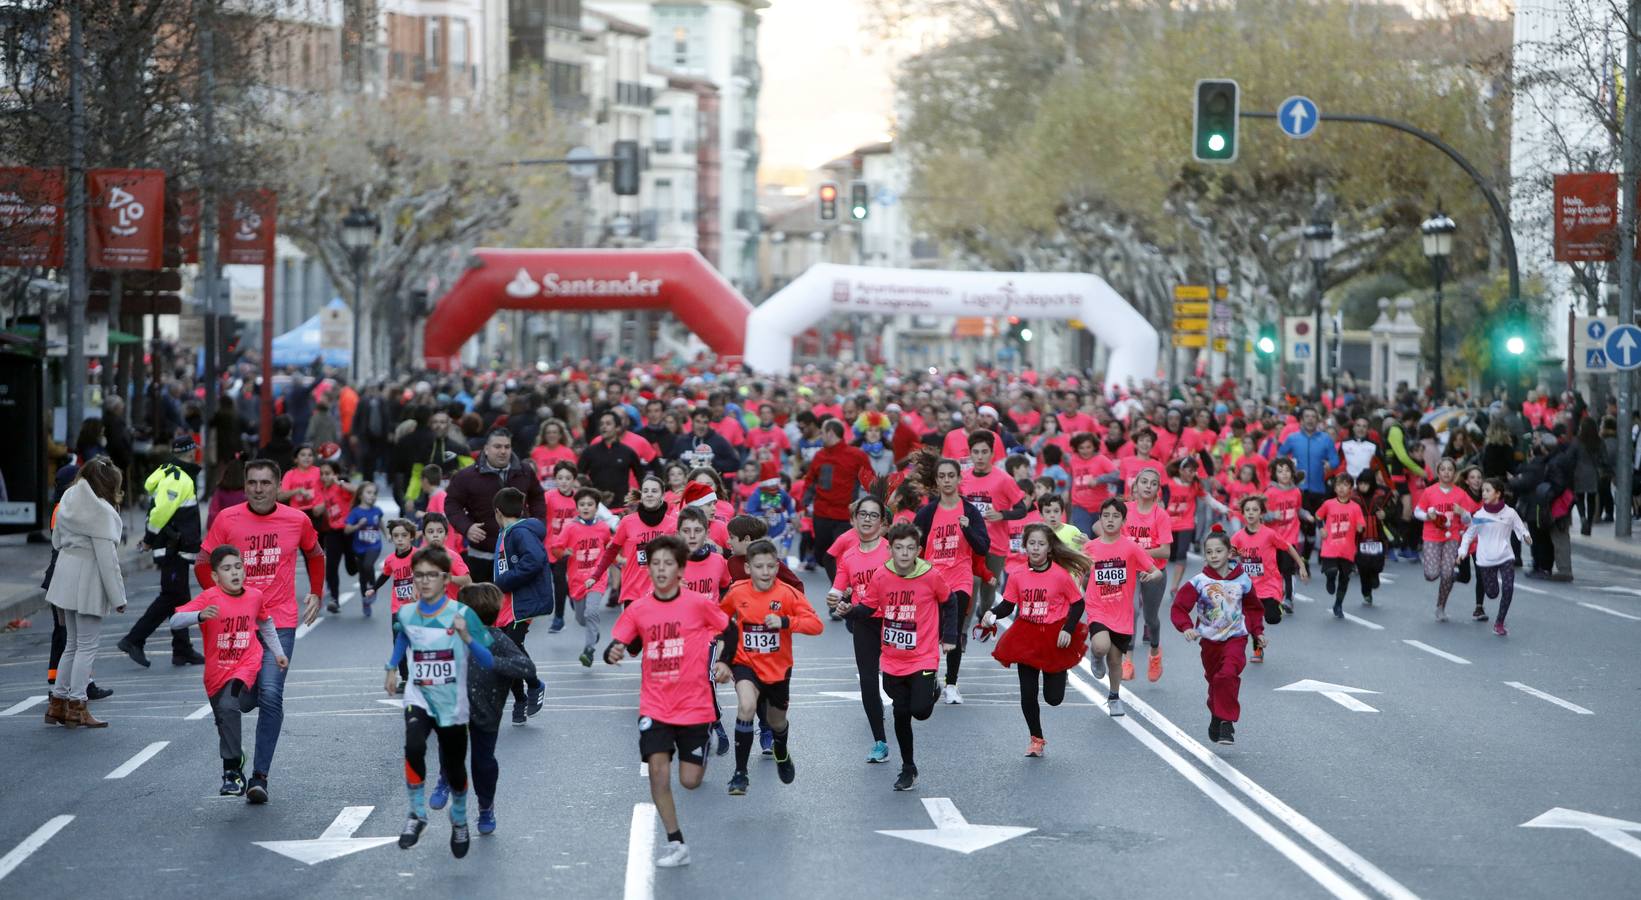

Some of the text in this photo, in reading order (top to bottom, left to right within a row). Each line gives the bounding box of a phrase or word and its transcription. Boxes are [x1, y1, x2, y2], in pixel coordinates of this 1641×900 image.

[542, 271, 664, 298] Santander
[946, 523, 957, 537] DIC
[1138, 526, 1151, 538] DIC
[263, 533, 279, 549] DIC
[1096, 568, 1124, 581] 8468
[1244, 564, 1261, 573] 025
[699, 578, 713, 593] DIC
[900, 590, 915, 605] DIC
[1034, 588, 1047, 602] DIC
[236, 615, 250, 632] DIC
[664, 621, 681, 639] DIC
[745, 633, 776, 647] 8134
[884, 628, 912, 645] 6780
[415, 662, 452, 678] 3709
